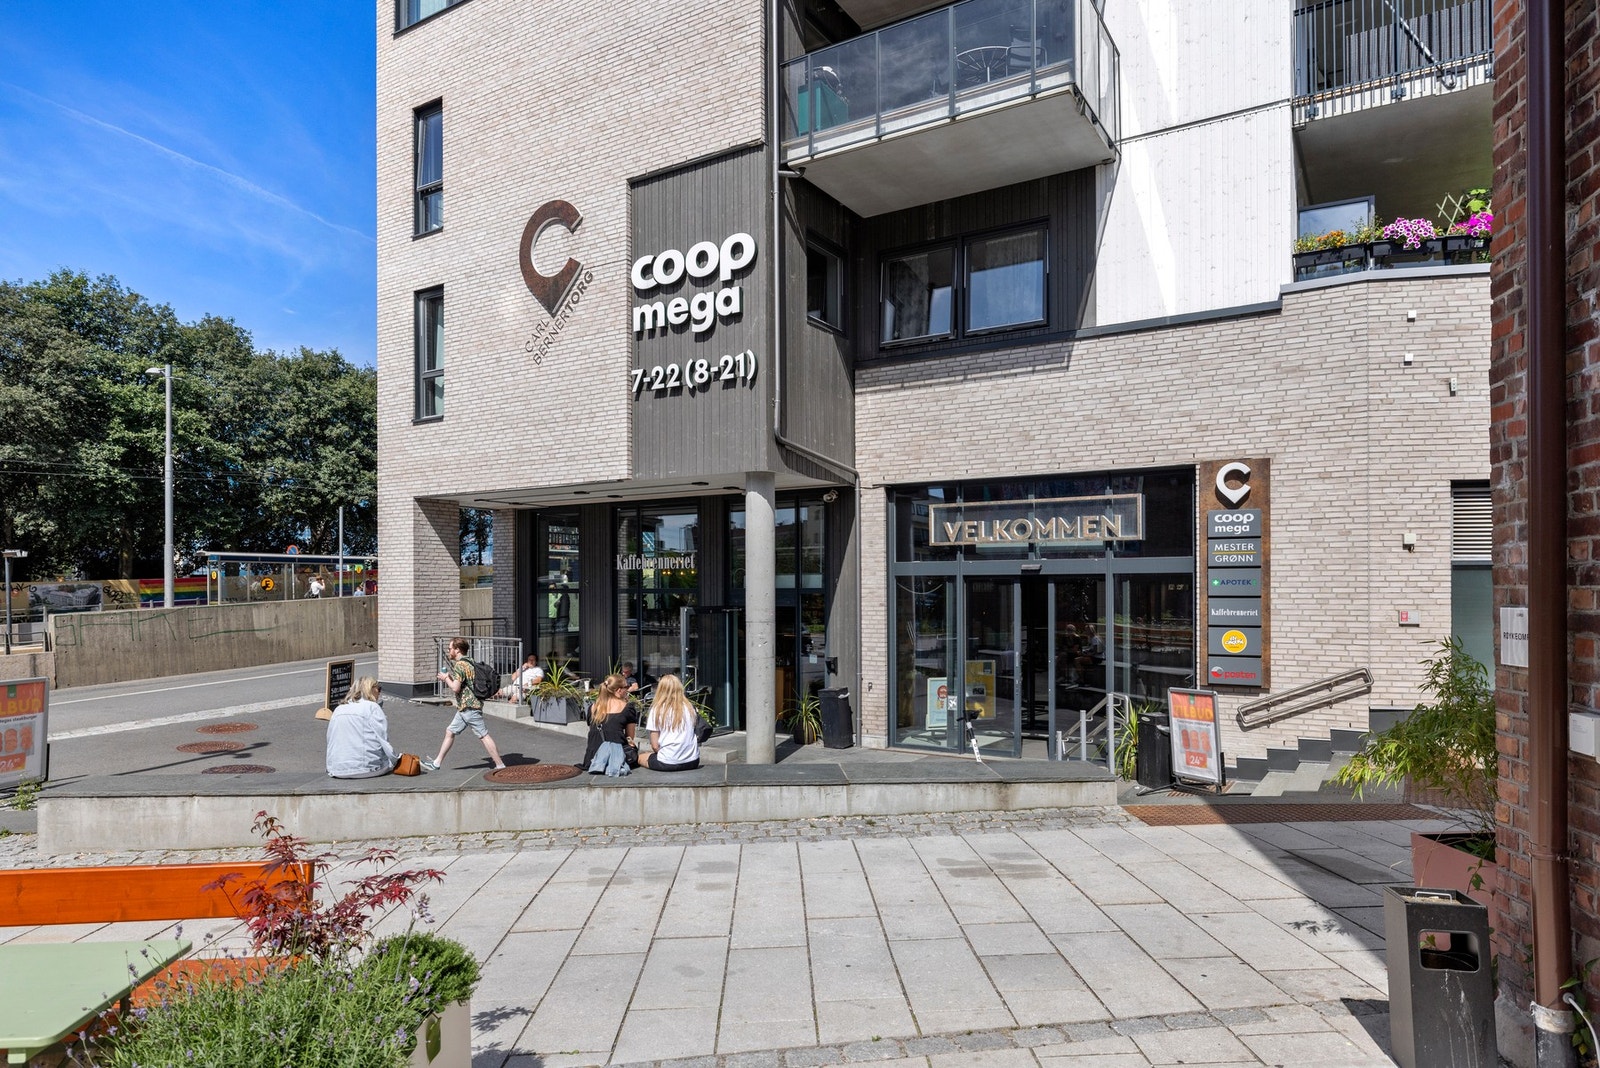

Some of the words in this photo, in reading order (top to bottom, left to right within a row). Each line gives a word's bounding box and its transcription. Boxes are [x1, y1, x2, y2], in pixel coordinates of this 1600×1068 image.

[631, 232, 756, 290] coop
[532, 270, 594, 365] BERNERTORG
[633, 286, 741, 333] mega
[525, 319, 550, 353] CARL
[631, 363, 681, 393] 7-22
[685, 349, 757, 389] (8-21)
[1214, 513, 1254, 524] coop
[943, 514, 1122, 543] VELKOMMEN
[1214, 524, 1250, 535] mega
[1214, 543, 1254, 552] MESTER
[616, 553, 696, 570] Kaffebrenneriet
[1215, 554, 1254, 563] GRØNN
[1211, 608, 1258, 617] Kaffebrenneriet
[1223, 671, 1257, 680] posten
[0, 698, 41, 715] LBUD
